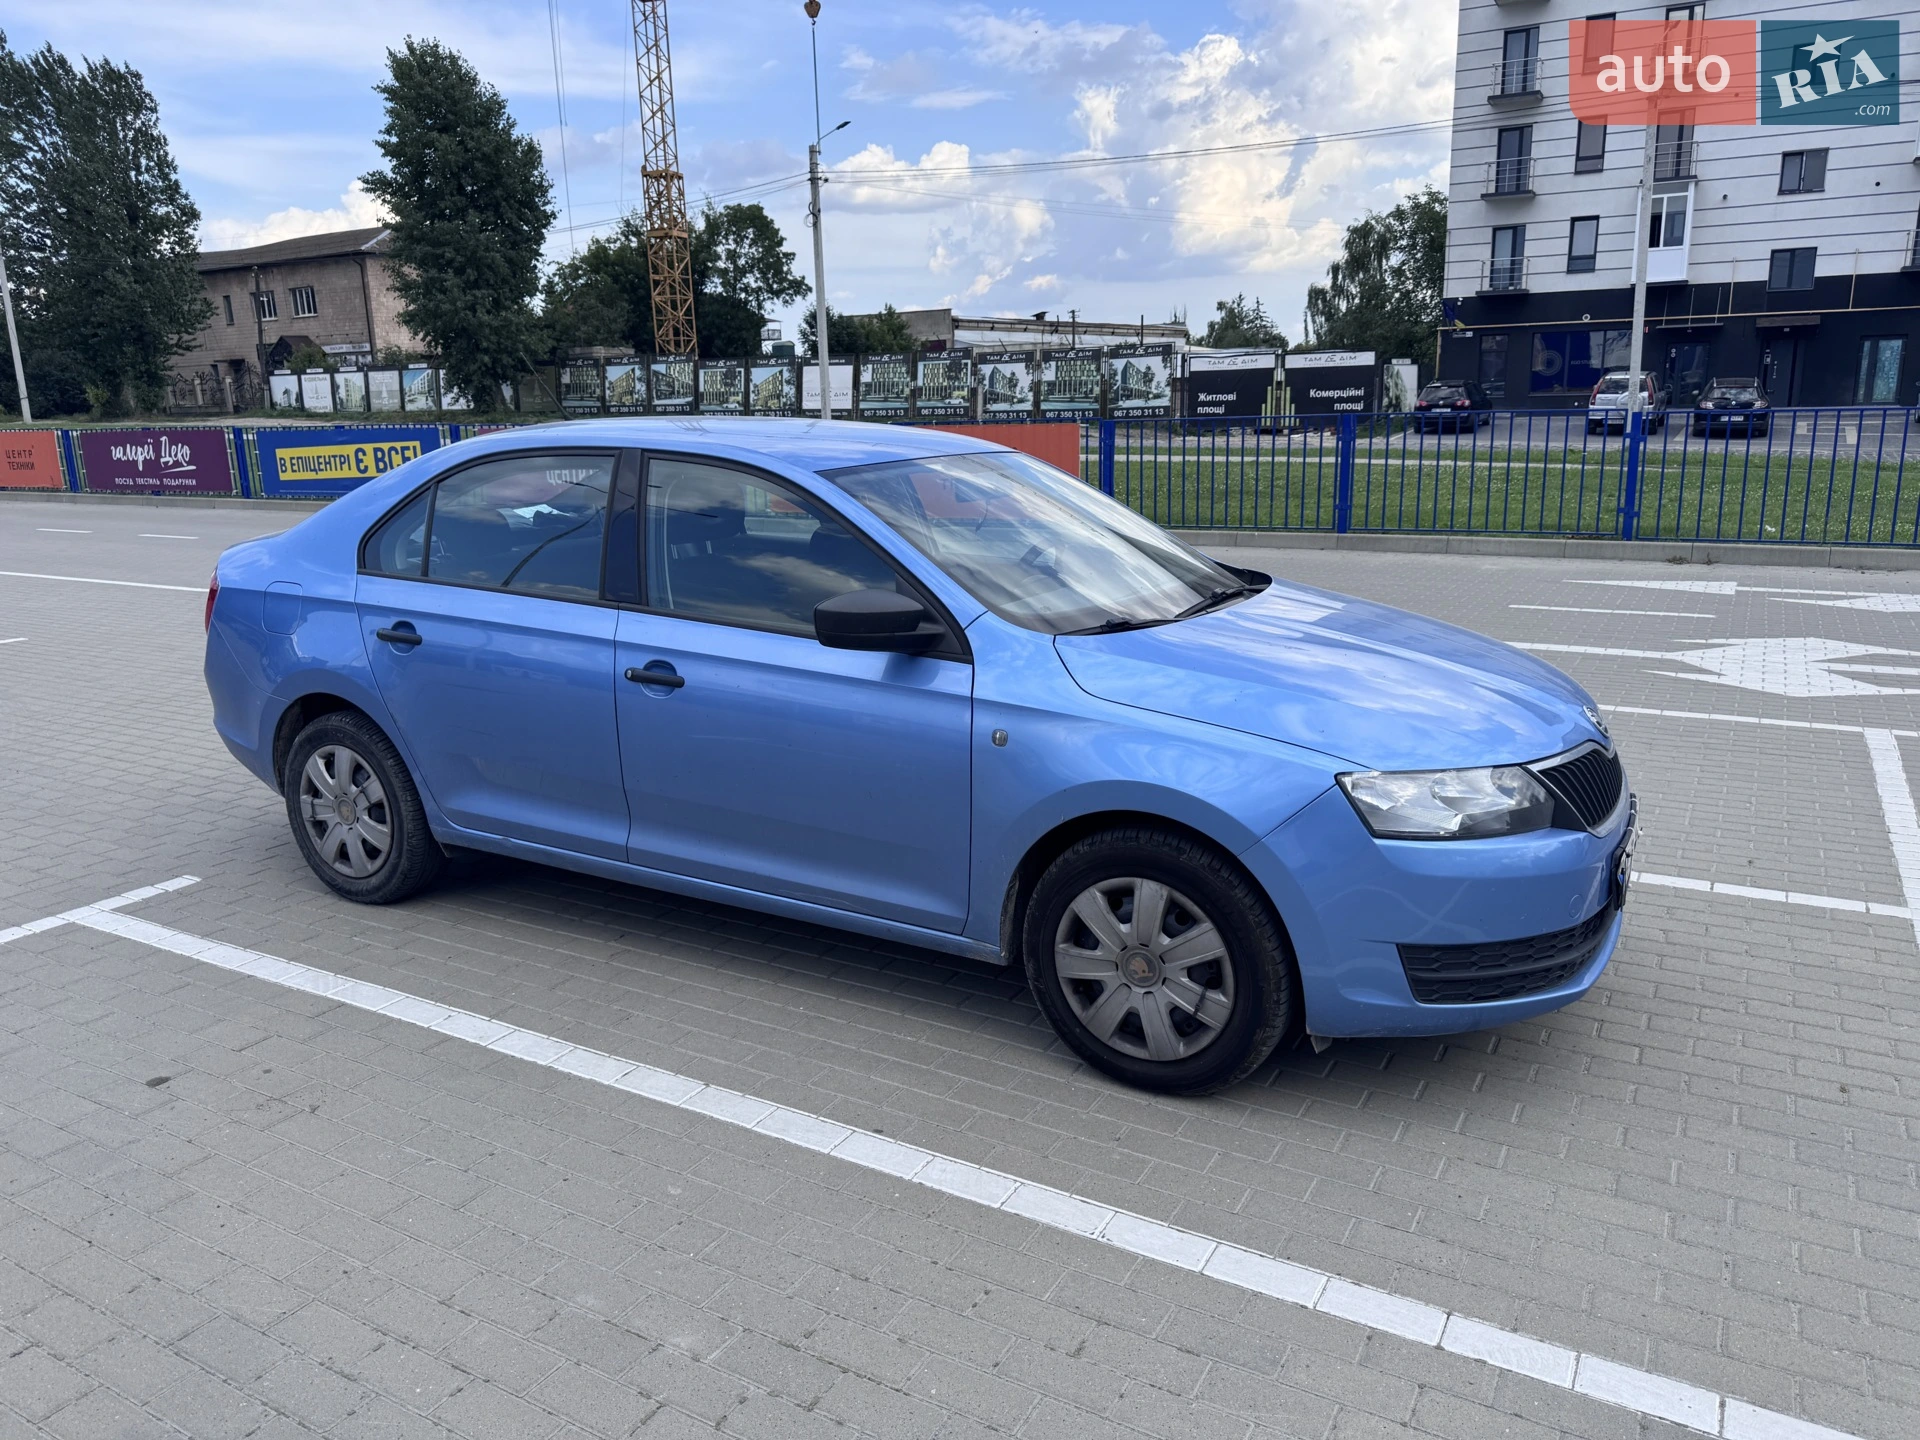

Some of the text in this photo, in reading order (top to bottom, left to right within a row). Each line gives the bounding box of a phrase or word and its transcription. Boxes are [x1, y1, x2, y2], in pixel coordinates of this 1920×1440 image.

[1198, 392, 1236, 401] Житлові
[1310, 387, 1364, 399] Комерційні
[1197, 404, 1225, 414] площі
[1334, 401, 1364, 411] площі
[6, 450, 33, 459] ЦЕНТР
[110, 436, 190, 472] галереї Деко
[7, 461, 35, 470] ТЕХНІКИ
[279, 457, 288, 473] В
[290, 454, 351, 475] ЕПІЦЕНТРІ
[354, 447, 369, 474] Є
